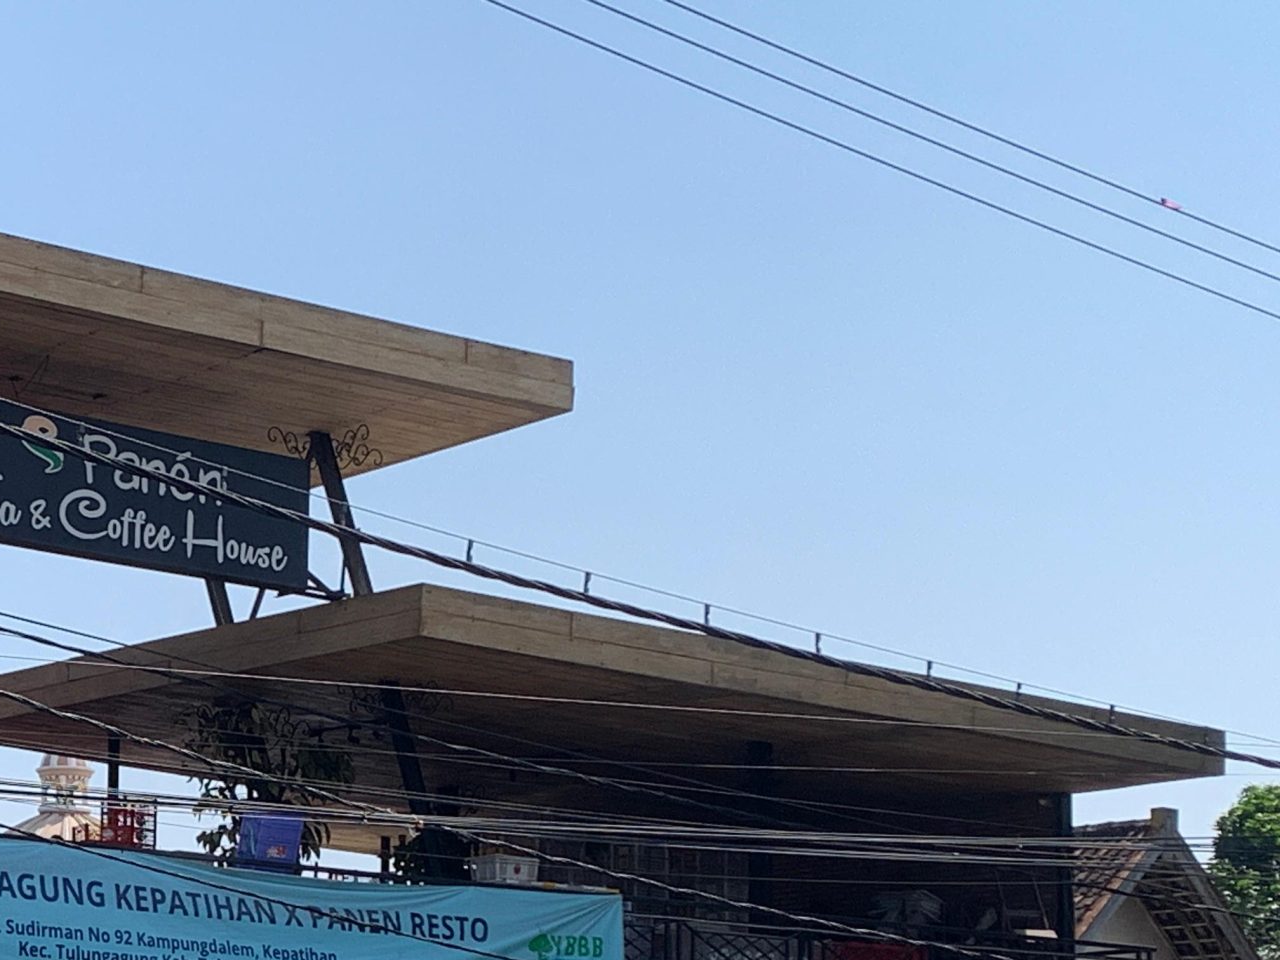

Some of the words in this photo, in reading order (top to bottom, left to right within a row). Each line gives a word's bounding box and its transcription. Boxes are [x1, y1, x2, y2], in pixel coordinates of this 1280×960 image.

[31, 499, 51, 529] &
[58, 489, 176, 552] Coffee
[182, 509, 288, 571] House
[115, 883, 277, 926] KEPATIHAN
[284, 903, 304, 928] X
[310, 905, 402, 935] PANEN
[411, 911, 489, 943] RESTO
[6, 919, 83, 941] Sudirman
[88, 927, 110, 943] No
[115, 930, 132, 945] 92
[137, 932, 259, 959] Kampungdalem,
[19, 941, 51, 959] Kec.
[551, 935, 604, 957] YBBB
